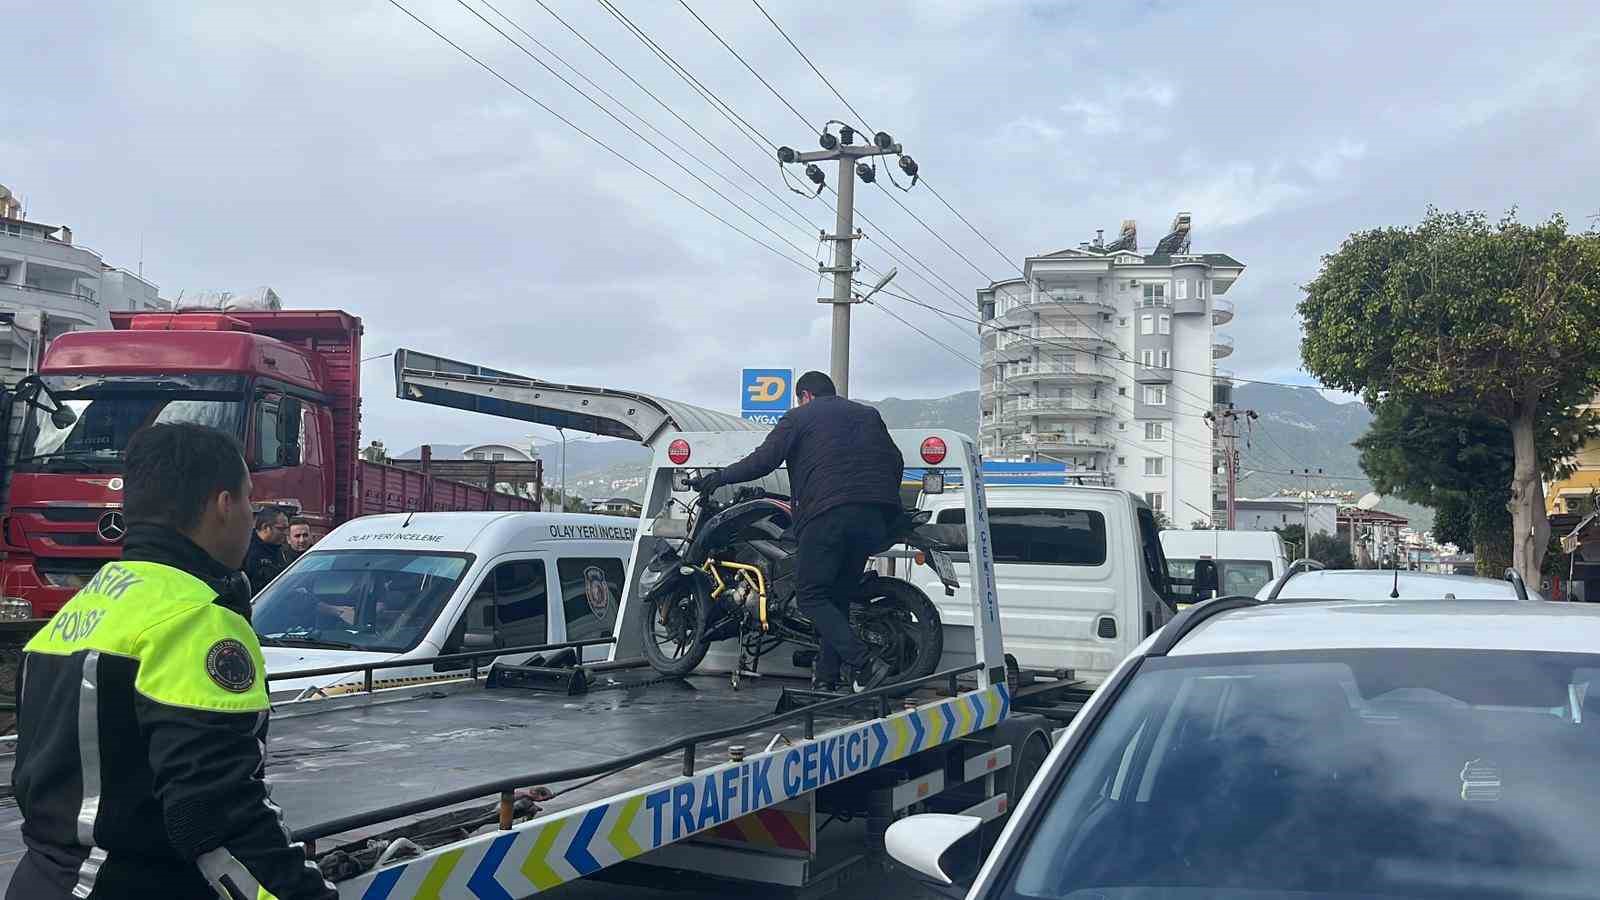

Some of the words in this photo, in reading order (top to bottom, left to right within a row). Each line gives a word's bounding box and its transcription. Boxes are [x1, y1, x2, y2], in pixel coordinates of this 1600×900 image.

[748, 415, 784, 425] AYGA
[549, 524, 575, 539] OLAY
[576, 523, 598, 540] YERİ
[598, 523, 638, 542] İNCELEM
[646, 756, 775, 849] TRAFİK
[783, 727, 869, 800] ÇEKİCİ
